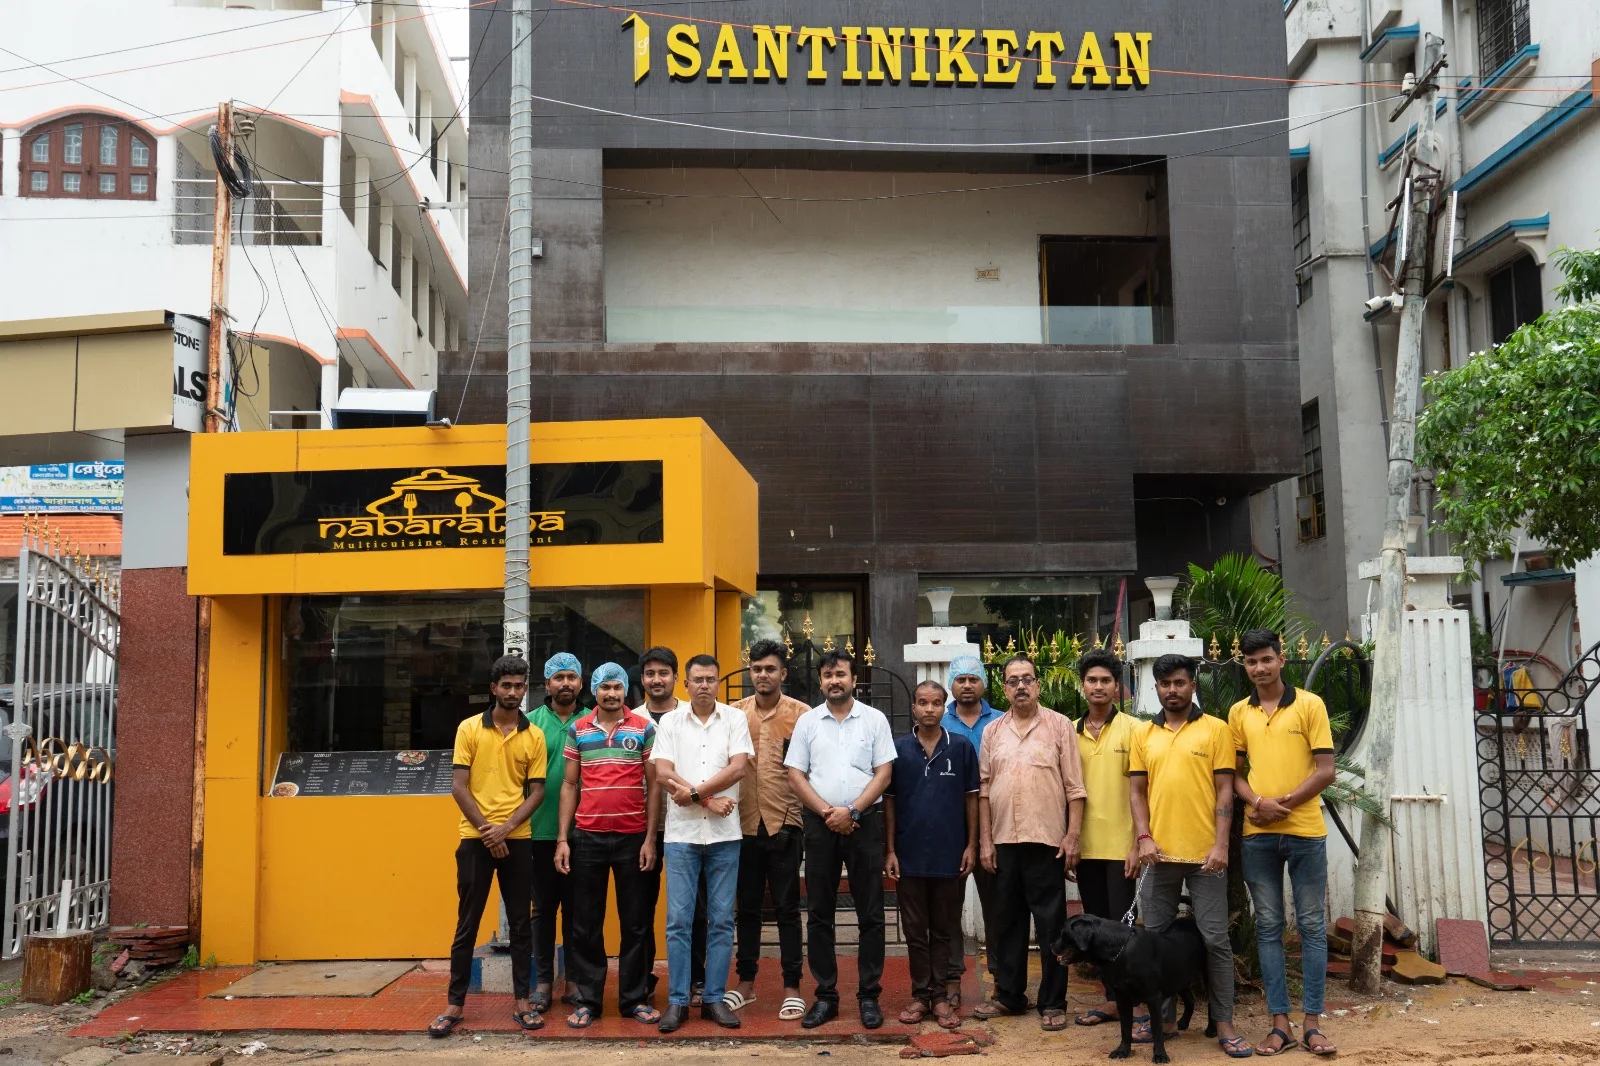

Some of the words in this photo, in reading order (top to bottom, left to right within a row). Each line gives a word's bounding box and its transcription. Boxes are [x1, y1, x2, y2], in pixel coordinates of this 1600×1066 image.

[666, 24, 1153, 87] SANTINIKETAN
[333, 538, 443, 550] Multicuisine
[460, 535, 553, 547] Restaant
